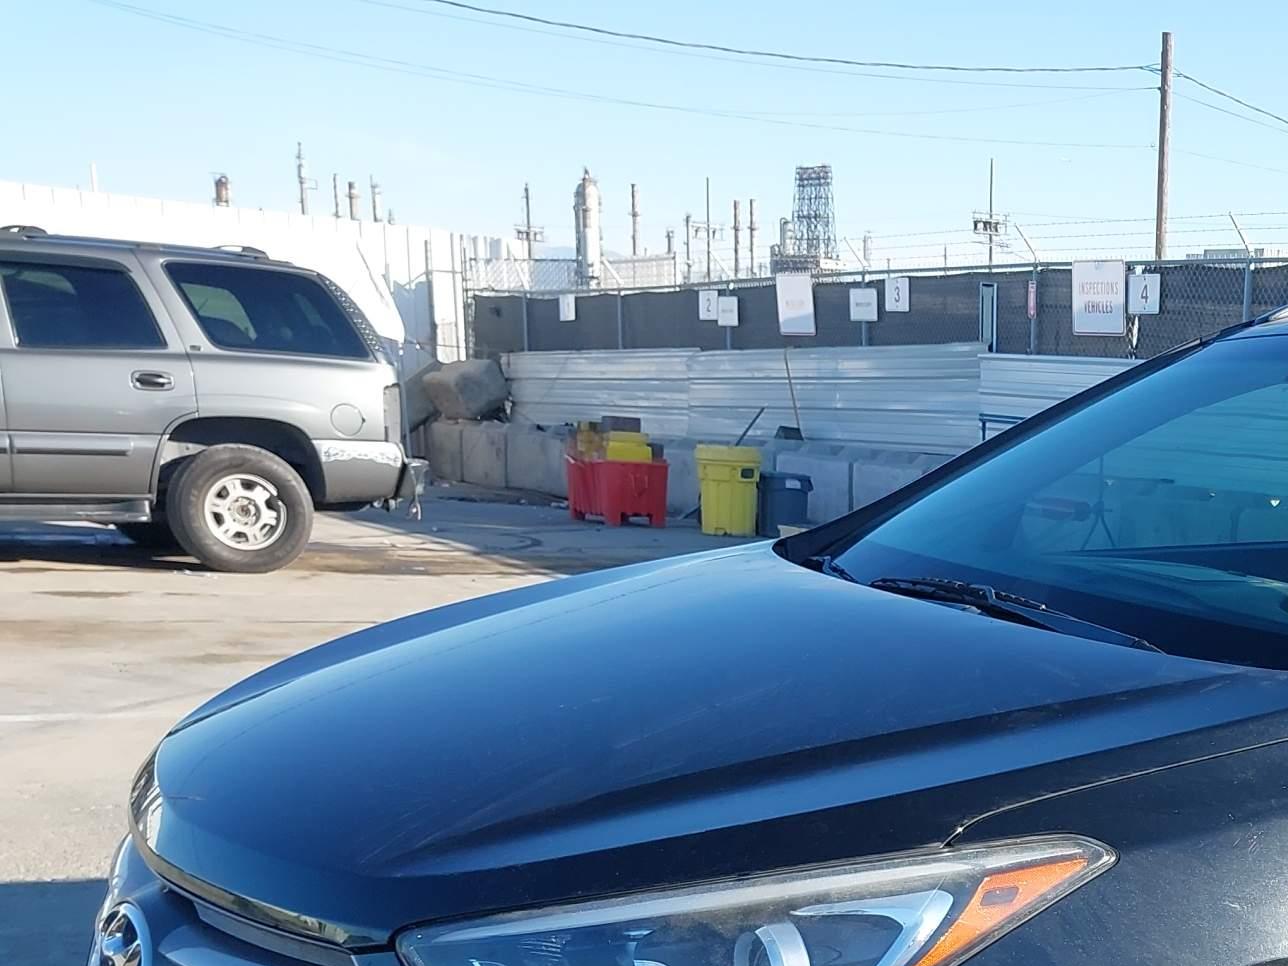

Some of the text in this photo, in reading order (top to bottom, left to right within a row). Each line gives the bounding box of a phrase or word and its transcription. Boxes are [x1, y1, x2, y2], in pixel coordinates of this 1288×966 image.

[894, 286, 901, 303] 3
[1079, 281, 1119, 296] INSPECTIONS
[1140, 284, 1149, 304] 4
[705, 298, 712, 313] 2
[1084, 301, 1113, 313] VEHICLES
